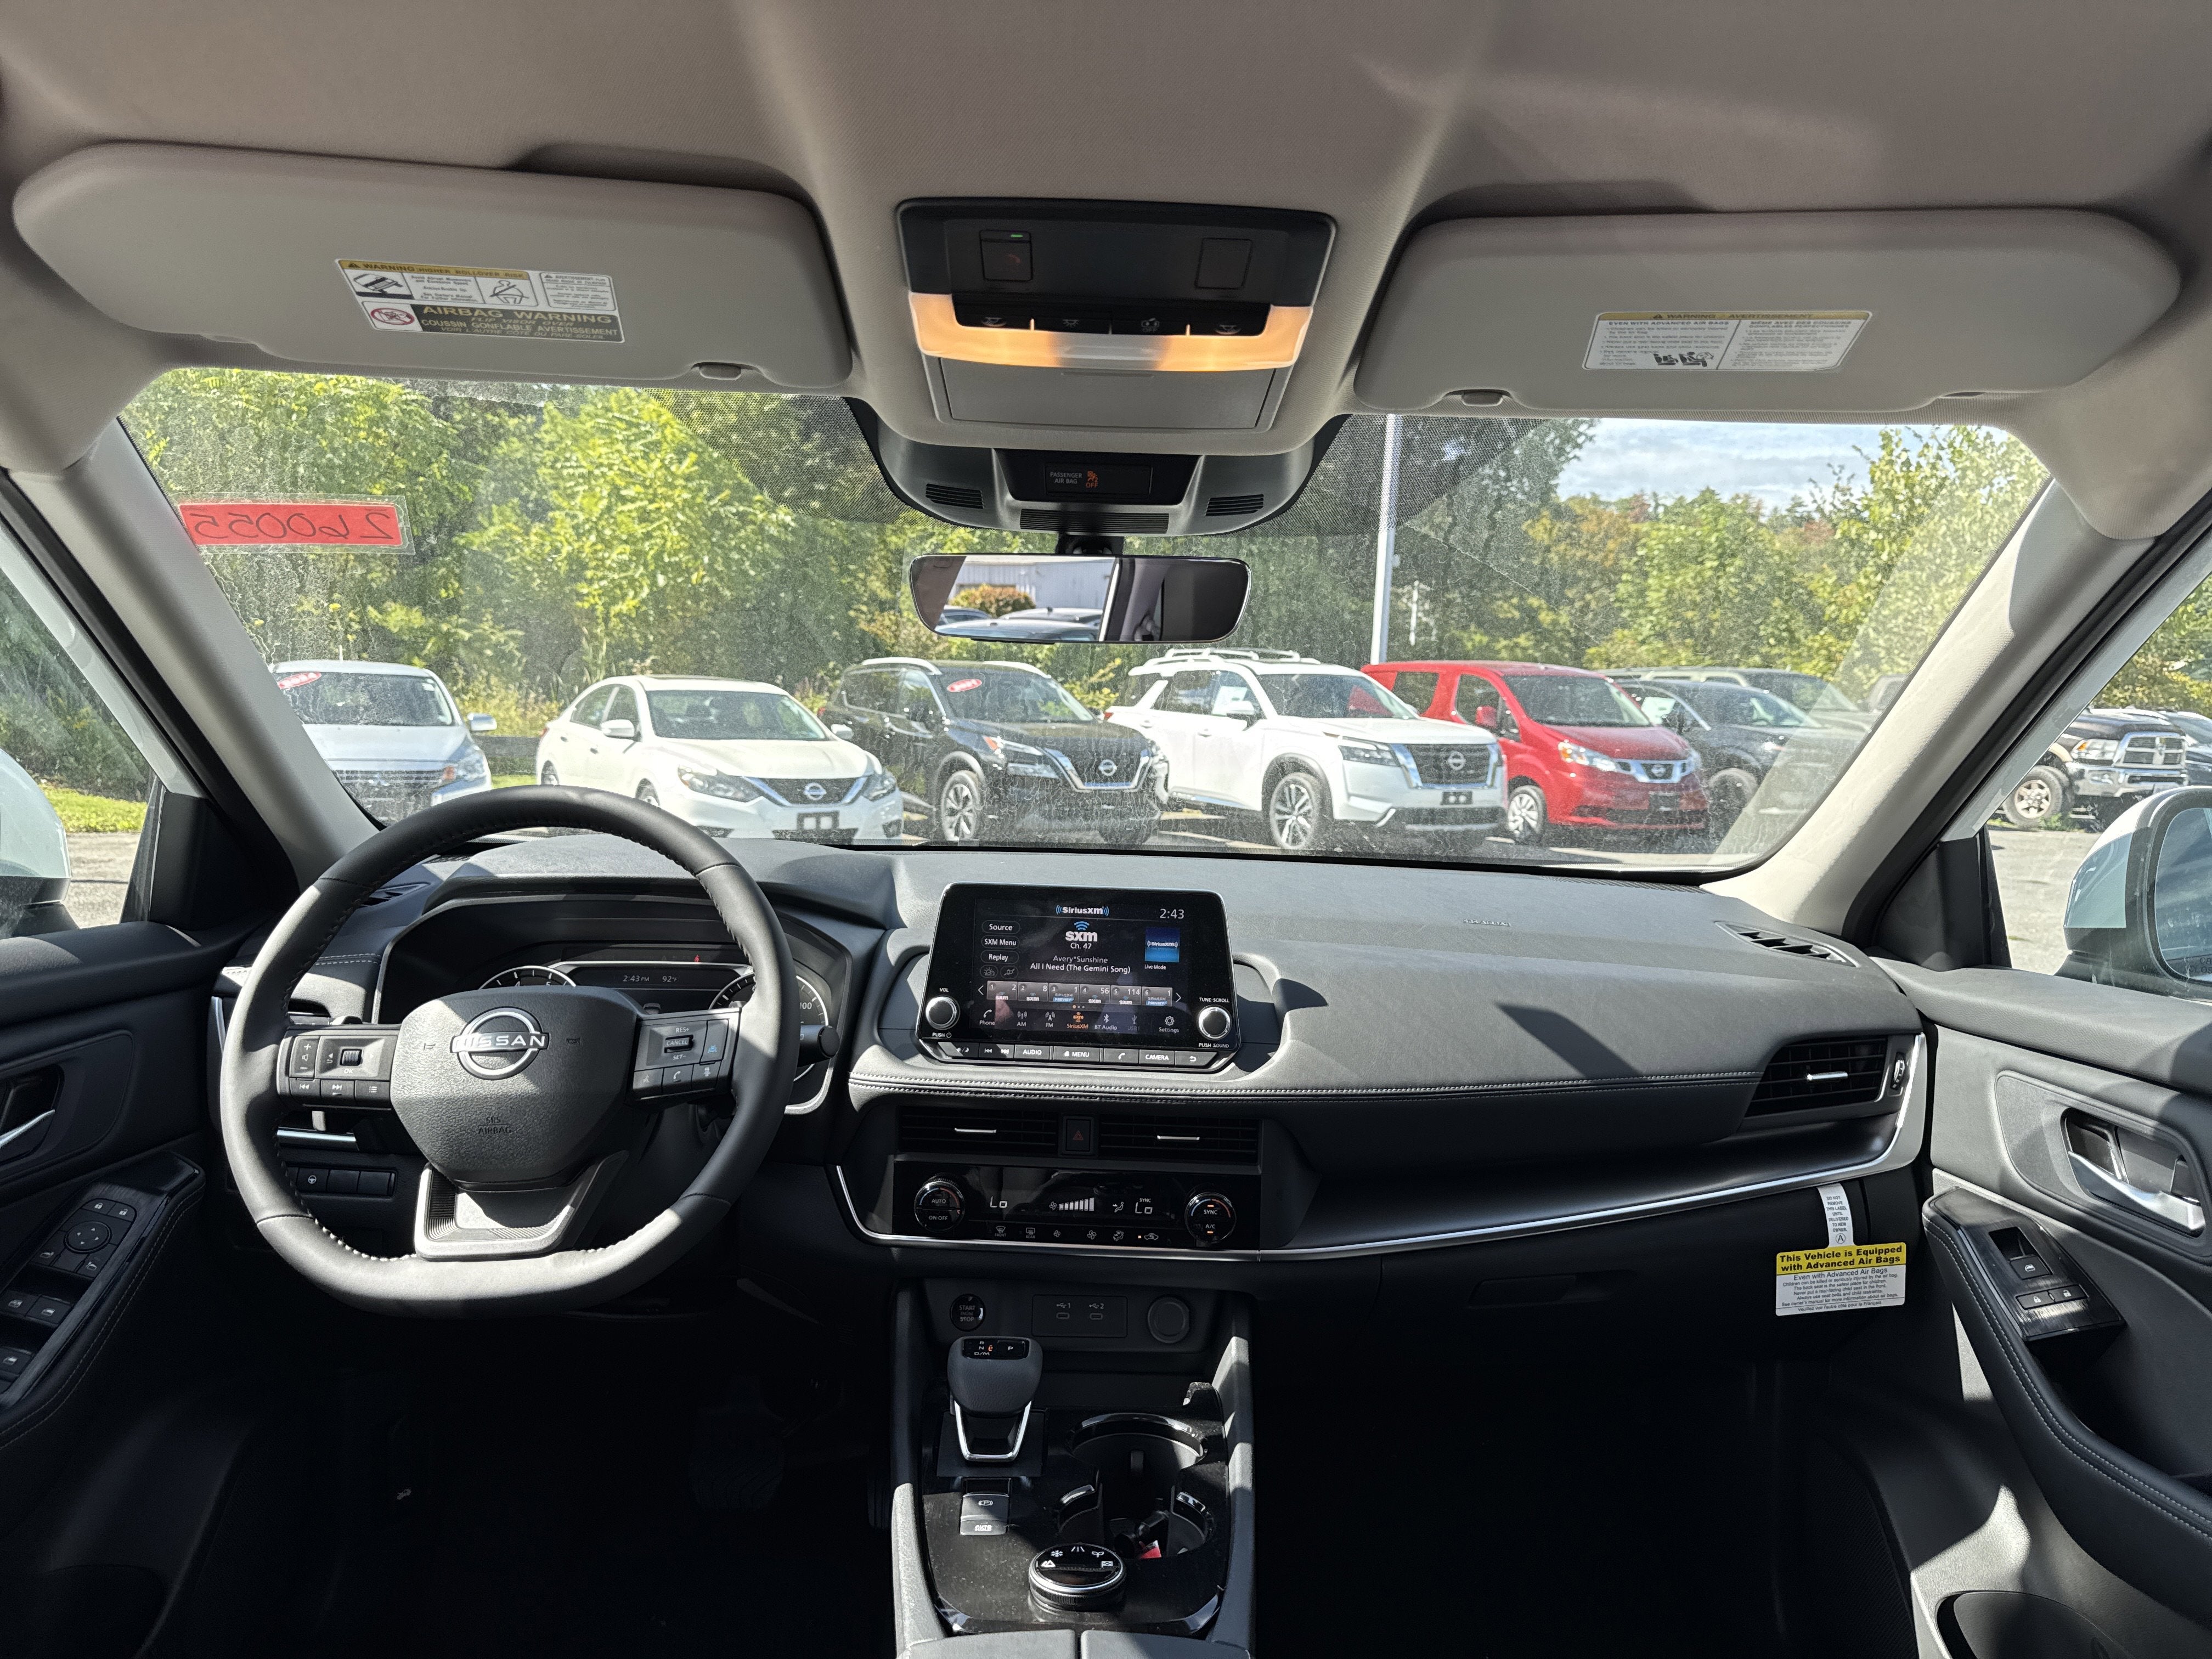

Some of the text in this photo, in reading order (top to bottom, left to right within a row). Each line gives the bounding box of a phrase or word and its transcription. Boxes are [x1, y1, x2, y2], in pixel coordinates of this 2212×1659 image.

[423, 306, 612, 324] AIRBAG WARNING
[421, 319, 617, 336] COUSSIN GONFLABLE AVERTISSEMENT
[1160, 909, 1184, 919] 2:43
[1065, 931, 1097, 941] sxm
[989, 953, 1008, 962] Replay
[455, 1035, 545, 1048] NISSAN
[990, 1196, 1008, 1208] Lo
[1135, 1202, 1153, 1214] Lo
[1780, 1254, 1801, 1262] This
[1804, 1250, 1841, 1260] Vehicle
[1856, 1245, 1902, 1256] Equipped
[1781, 1263, 1803, 1272] with
[1807, 1259, 1855, 1269] Advanced
[1876, 1256, 1900, 1264] Bags
[1826, 1269, 1858, 1278] Advanced
